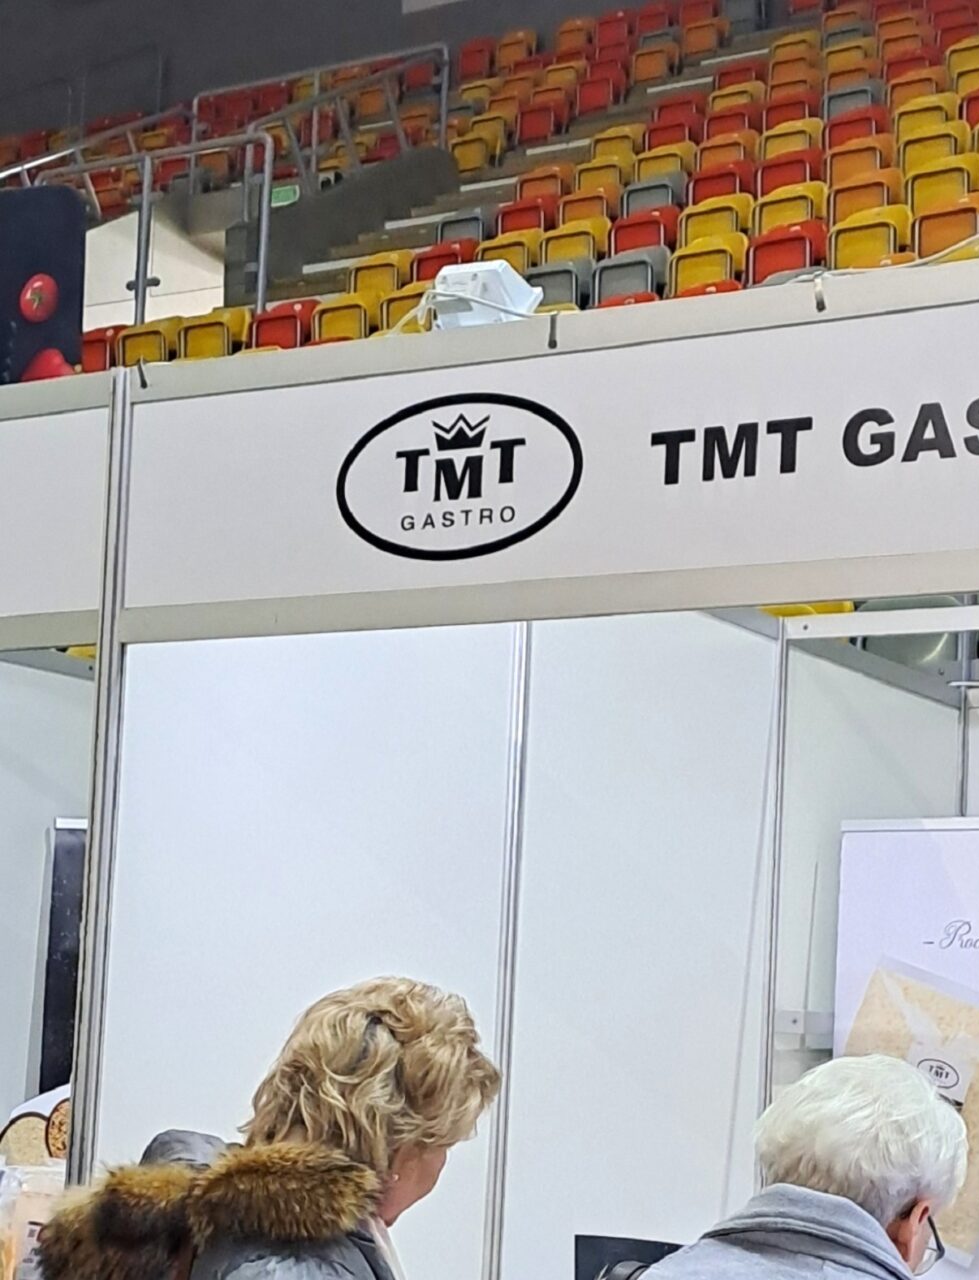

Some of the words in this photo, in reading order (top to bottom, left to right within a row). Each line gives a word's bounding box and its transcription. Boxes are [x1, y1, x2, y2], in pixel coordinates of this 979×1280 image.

[396, 437, 527, 502] TMT
[651, 416, 813, 486] TMT
[400, 505, 516, 531] GASTRO
